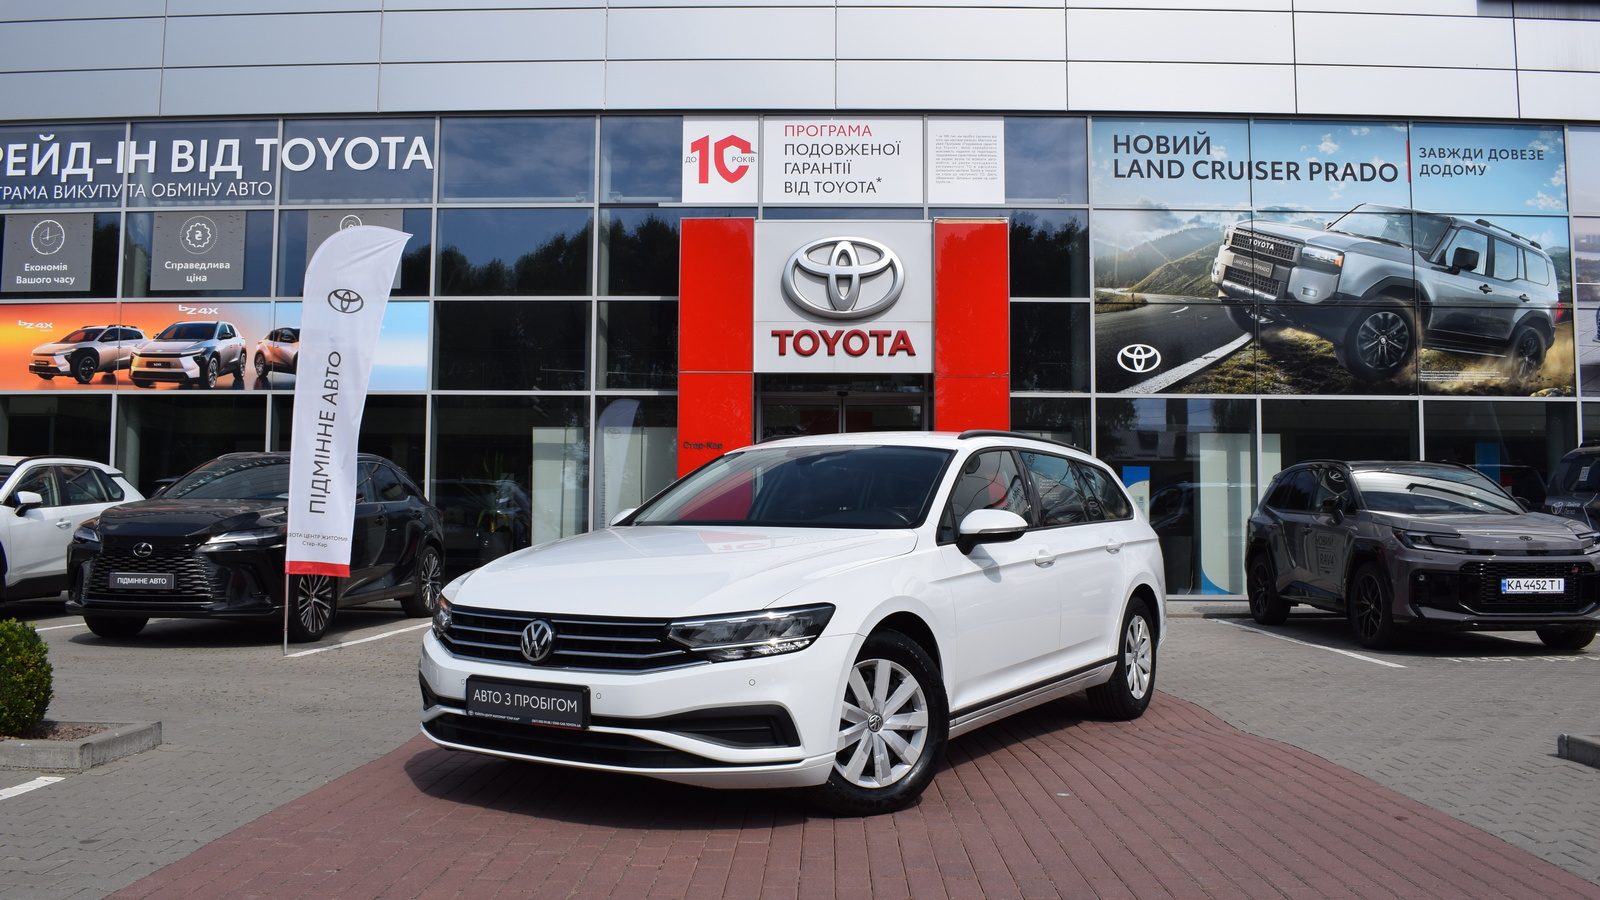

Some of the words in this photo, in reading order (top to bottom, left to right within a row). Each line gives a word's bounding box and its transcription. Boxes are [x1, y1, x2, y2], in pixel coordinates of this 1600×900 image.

[784, 125, 872, 137] ПРОГРАМА
[784, 141, 902, 157] ПОДОВЖЕНОЇ
[1113, 131, 1211, 155] НОВИЙ
[0, 133, 157, 182] ЕЙД-ІН
[171, 139, 243, 180] ВІД
[255, 136, 434, 171] TOYOTA
[685, 156, 697, 164] ДО
[1419, 147, 1484, 161] ЗАВЖДИ
[1488, 148, 1545, 161] ДОВЕЗЕ
[784, 160, 852, 175] ГАРАНТІЇ
[1114, 159, 1185, 179] LAND
[1192, 160, 1301, 181] CRUISER
[1309, 162, 1399, 182] PRADO
[1419, 164, 1487, 177] ДОДОМУ
[54, 184, 124, 199] ВИКУПУ
[127, 184, 147, 198] ТА
[152, 182, 223, 198] ОБМІНУ
[226, 181, 273, 197] АВТО
[784, 181, 810, 195] ВІД
[1249, 238, 1275, 250] TOYOTA
[24, 263, 68, 272] Економія
[164, 261, 231, 271] Справедлива
[16, 276, 52, 285] Вашого
[53, 277, 76, 286] часу
[186, 274, 207, 283] ціна
[771, 329, 916, 356] TOYOTA
[322, 351, 342, 406] АВТО
[683, 441, 723, 450] Стар-Кар
[309, 410, 336, 514] ПІДМІННЕ
[117, 577, 148, 585] ПІДМІННЕ
[1507, 580, 1522, 590] KA
[1524, 580, 1547, 590] 4452
[1549, 580, 1561, 590] TI
[473, 689, 502, 704] АВТО
[514, 694, 578, 713] ПРОБІГОМ
